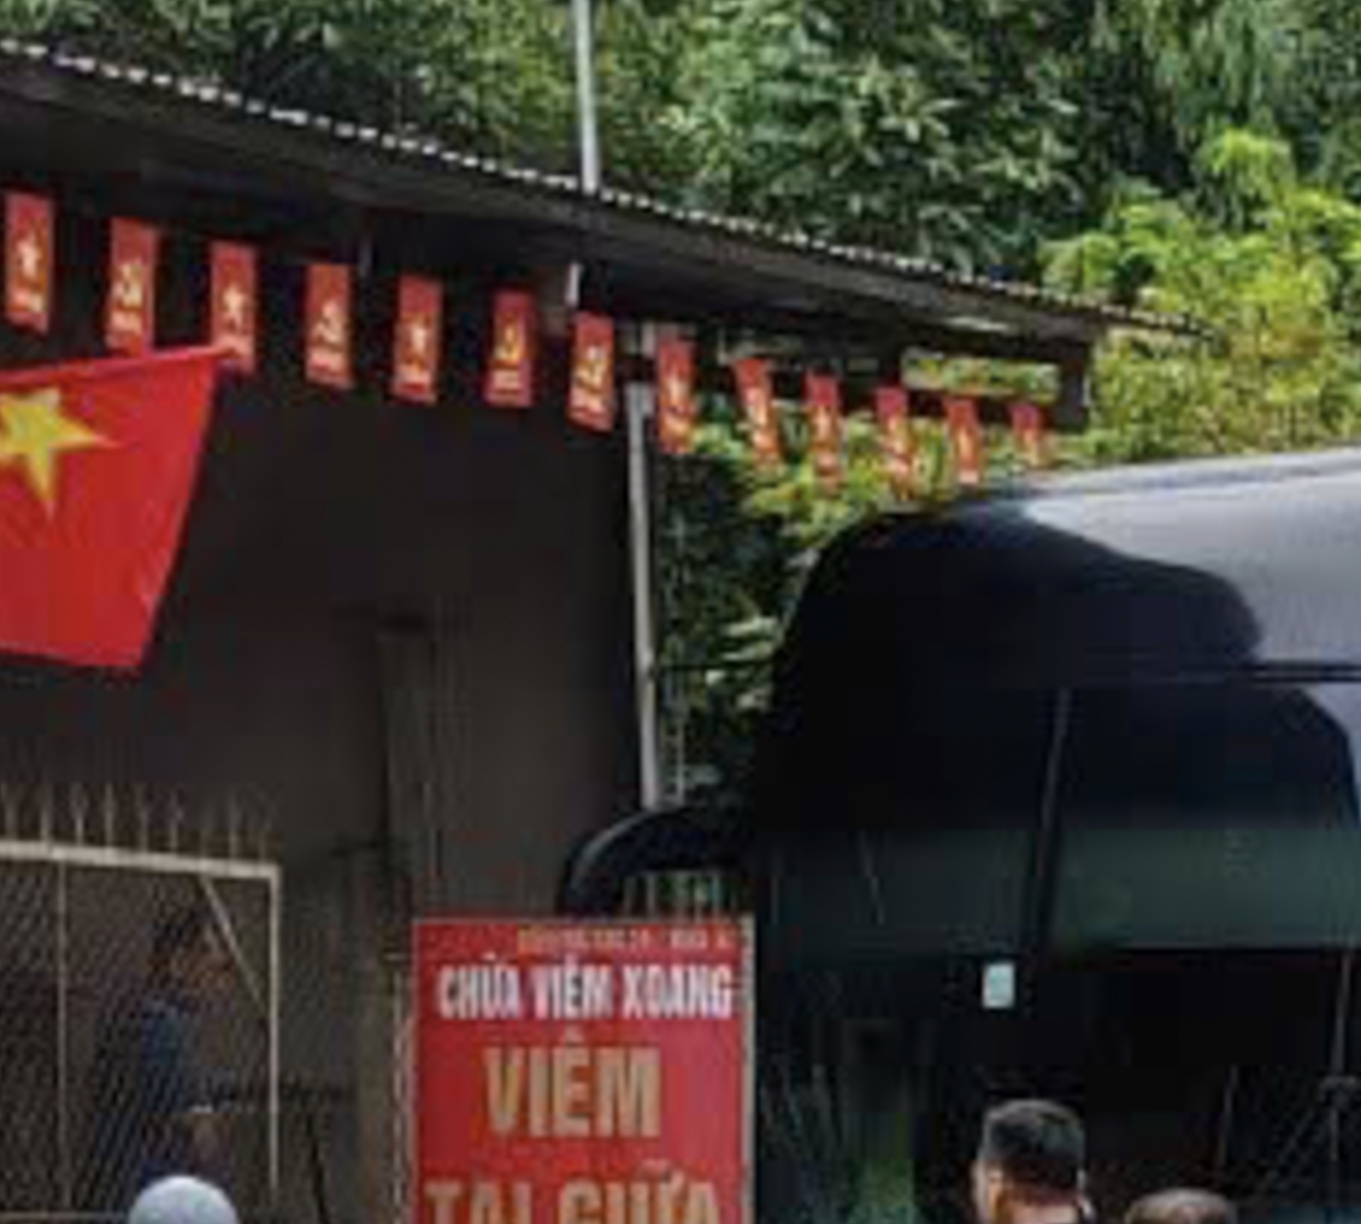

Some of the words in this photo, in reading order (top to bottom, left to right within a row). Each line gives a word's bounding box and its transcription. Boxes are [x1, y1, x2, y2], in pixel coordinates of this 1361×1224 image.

[530, 955, 613, 1020] VIÊM
[623, 963, 733, 1020] XOANG
[485, 1024, 660, 1138] VIÊM
